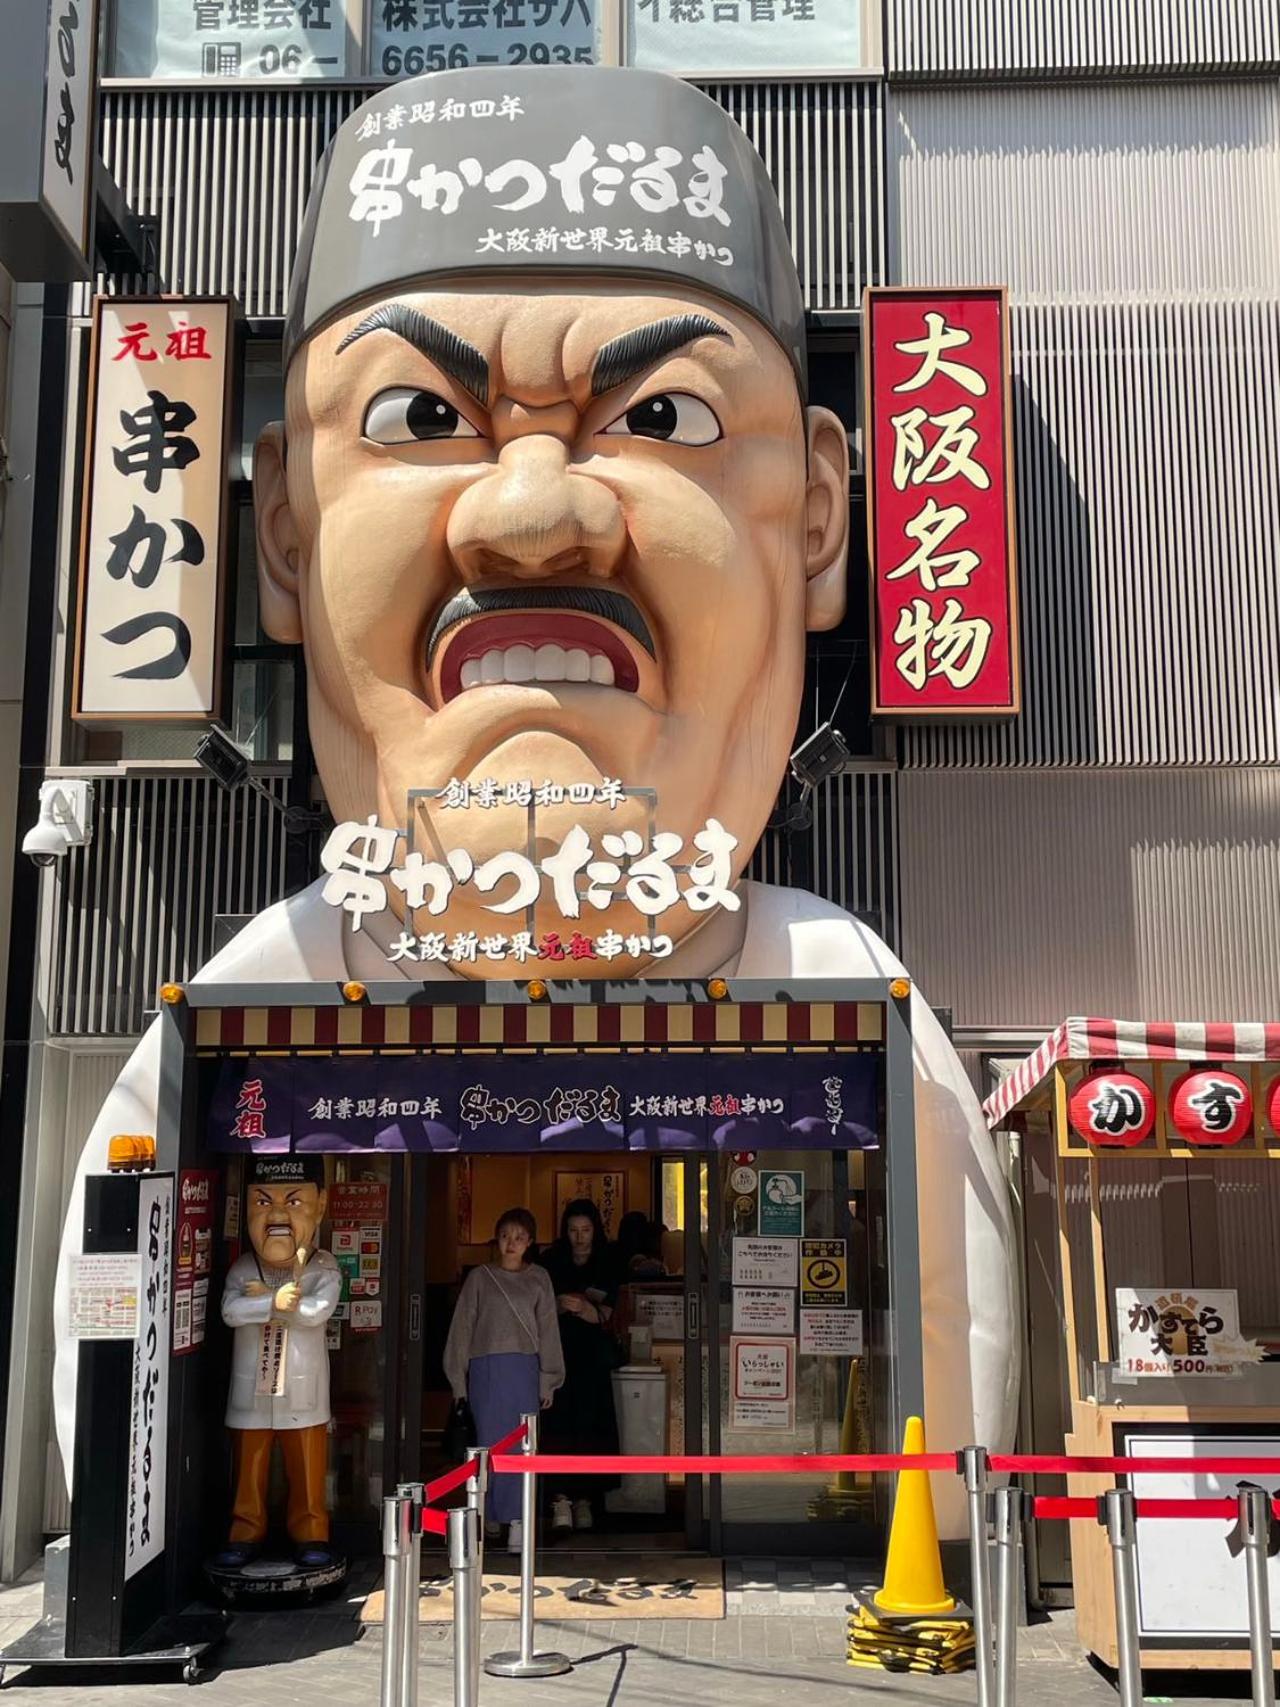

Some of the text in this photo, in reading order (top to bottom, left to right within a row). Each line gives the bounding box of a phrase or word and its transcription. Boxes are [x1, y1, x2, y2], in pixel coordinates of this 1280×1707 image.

[356, 95, 525, 140] 創業昭和四年
[349, 135, 731, 237] 串かつだるま
[475, 227, 734, 266] 大阪新世界元祖串かつ
[111, 321, 212, 363] 元祖
[886, 311, 992, 691] 大阪名物
[100, 390, 205, 680] 串かつ
[438, 777, 626, 809] 創業昭和四年
[320, 816, 741, 931] 串かつだるま
[387, 930, 673, 962] 大阪新世界元祖串かつ
[230, 1079, 266, 1139] 元祖
[308, 1097, 443, 1120] 創業昭和四年
[460, 1085, 621, 1130] 串かつだるま
[629, 1093, 784, 1116] 大阪新世界元祖串かつ
[1090, 1080, 1243, 1134] か す
[1128, 1303, 1224, 1335] かすてら
